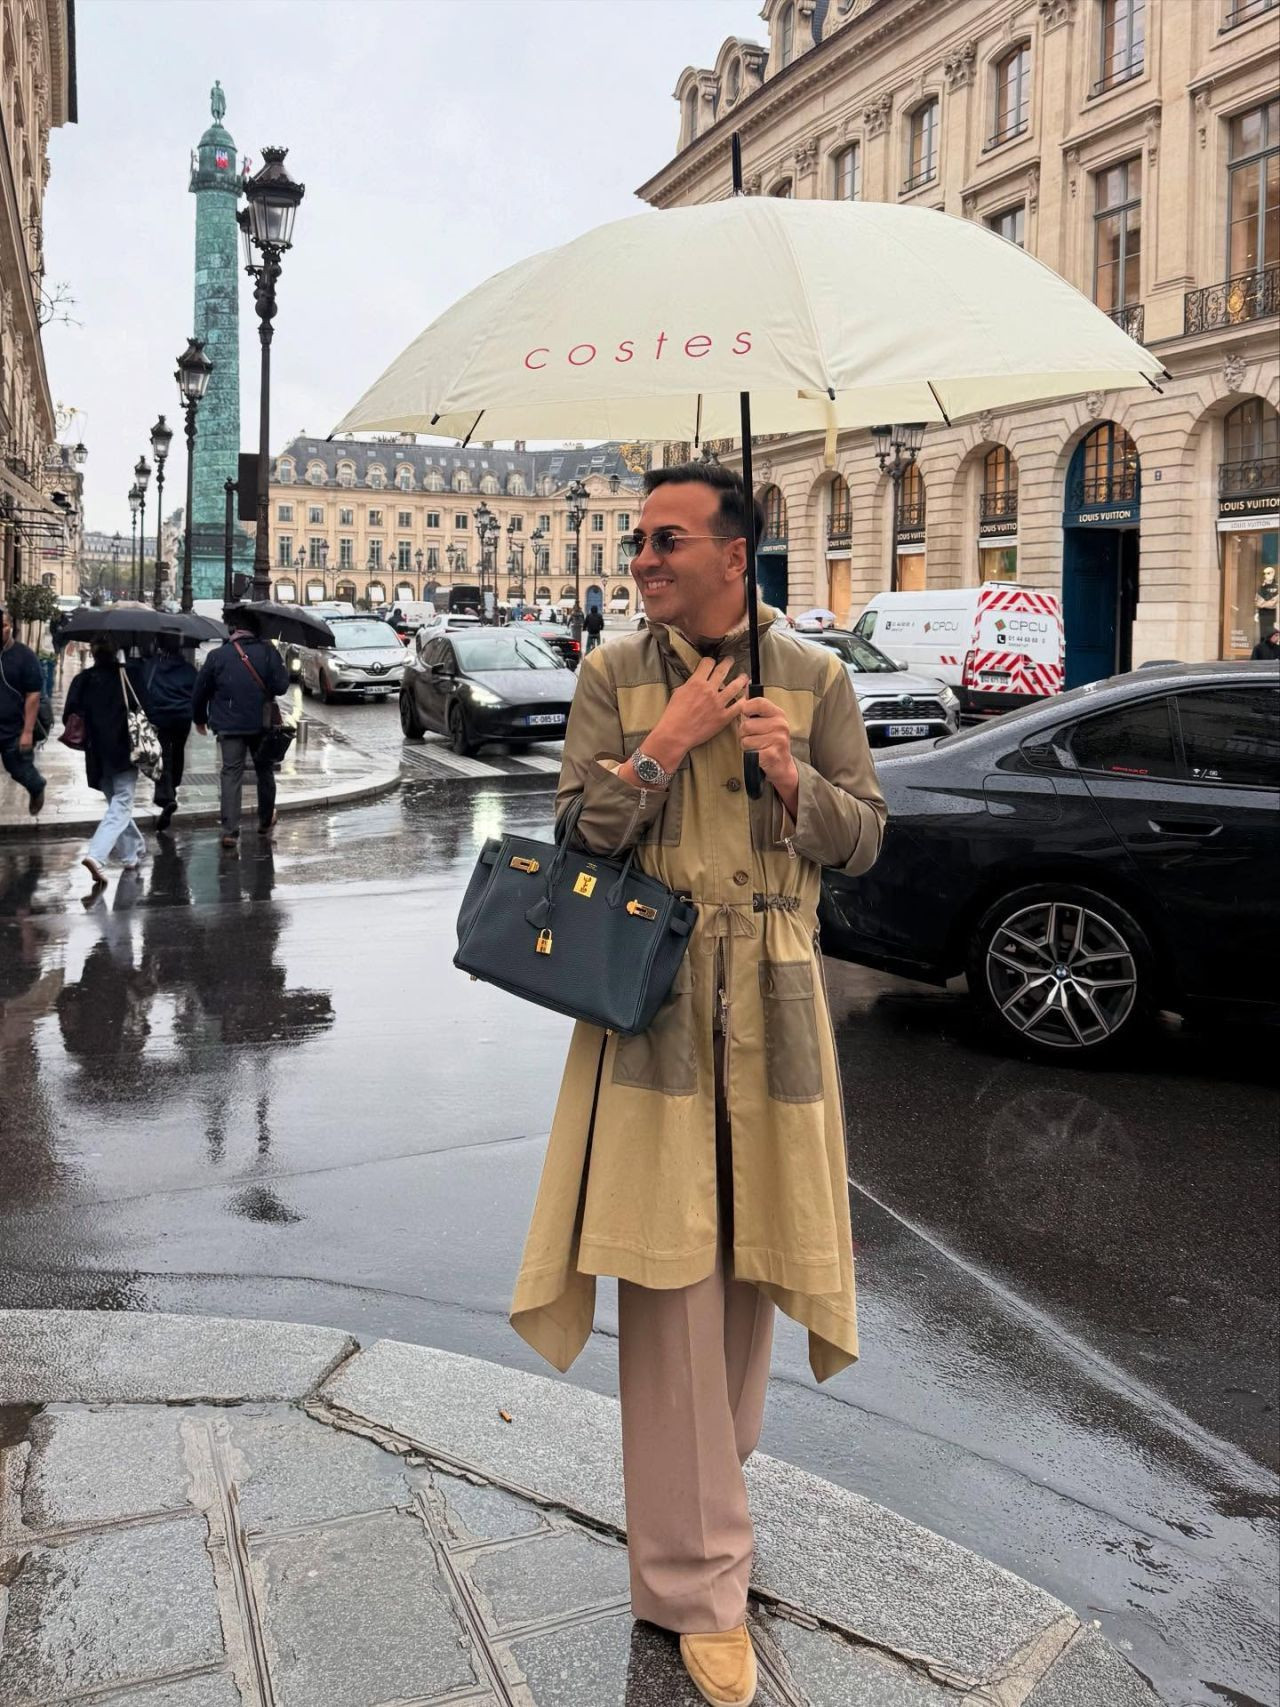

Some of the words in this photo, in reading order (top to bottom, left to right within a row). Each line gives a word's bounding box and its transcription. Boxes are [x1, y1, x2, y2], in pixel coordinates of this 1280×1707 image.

[524, 331, 753, 370] costes
[1220, 501, 1245, 512] LOUIS
[1079, 512, 1099, 523] LOUIS
[1101, 510, 1131, 521] VUITTON
[1009, 620, 1048, 633] CPCU
